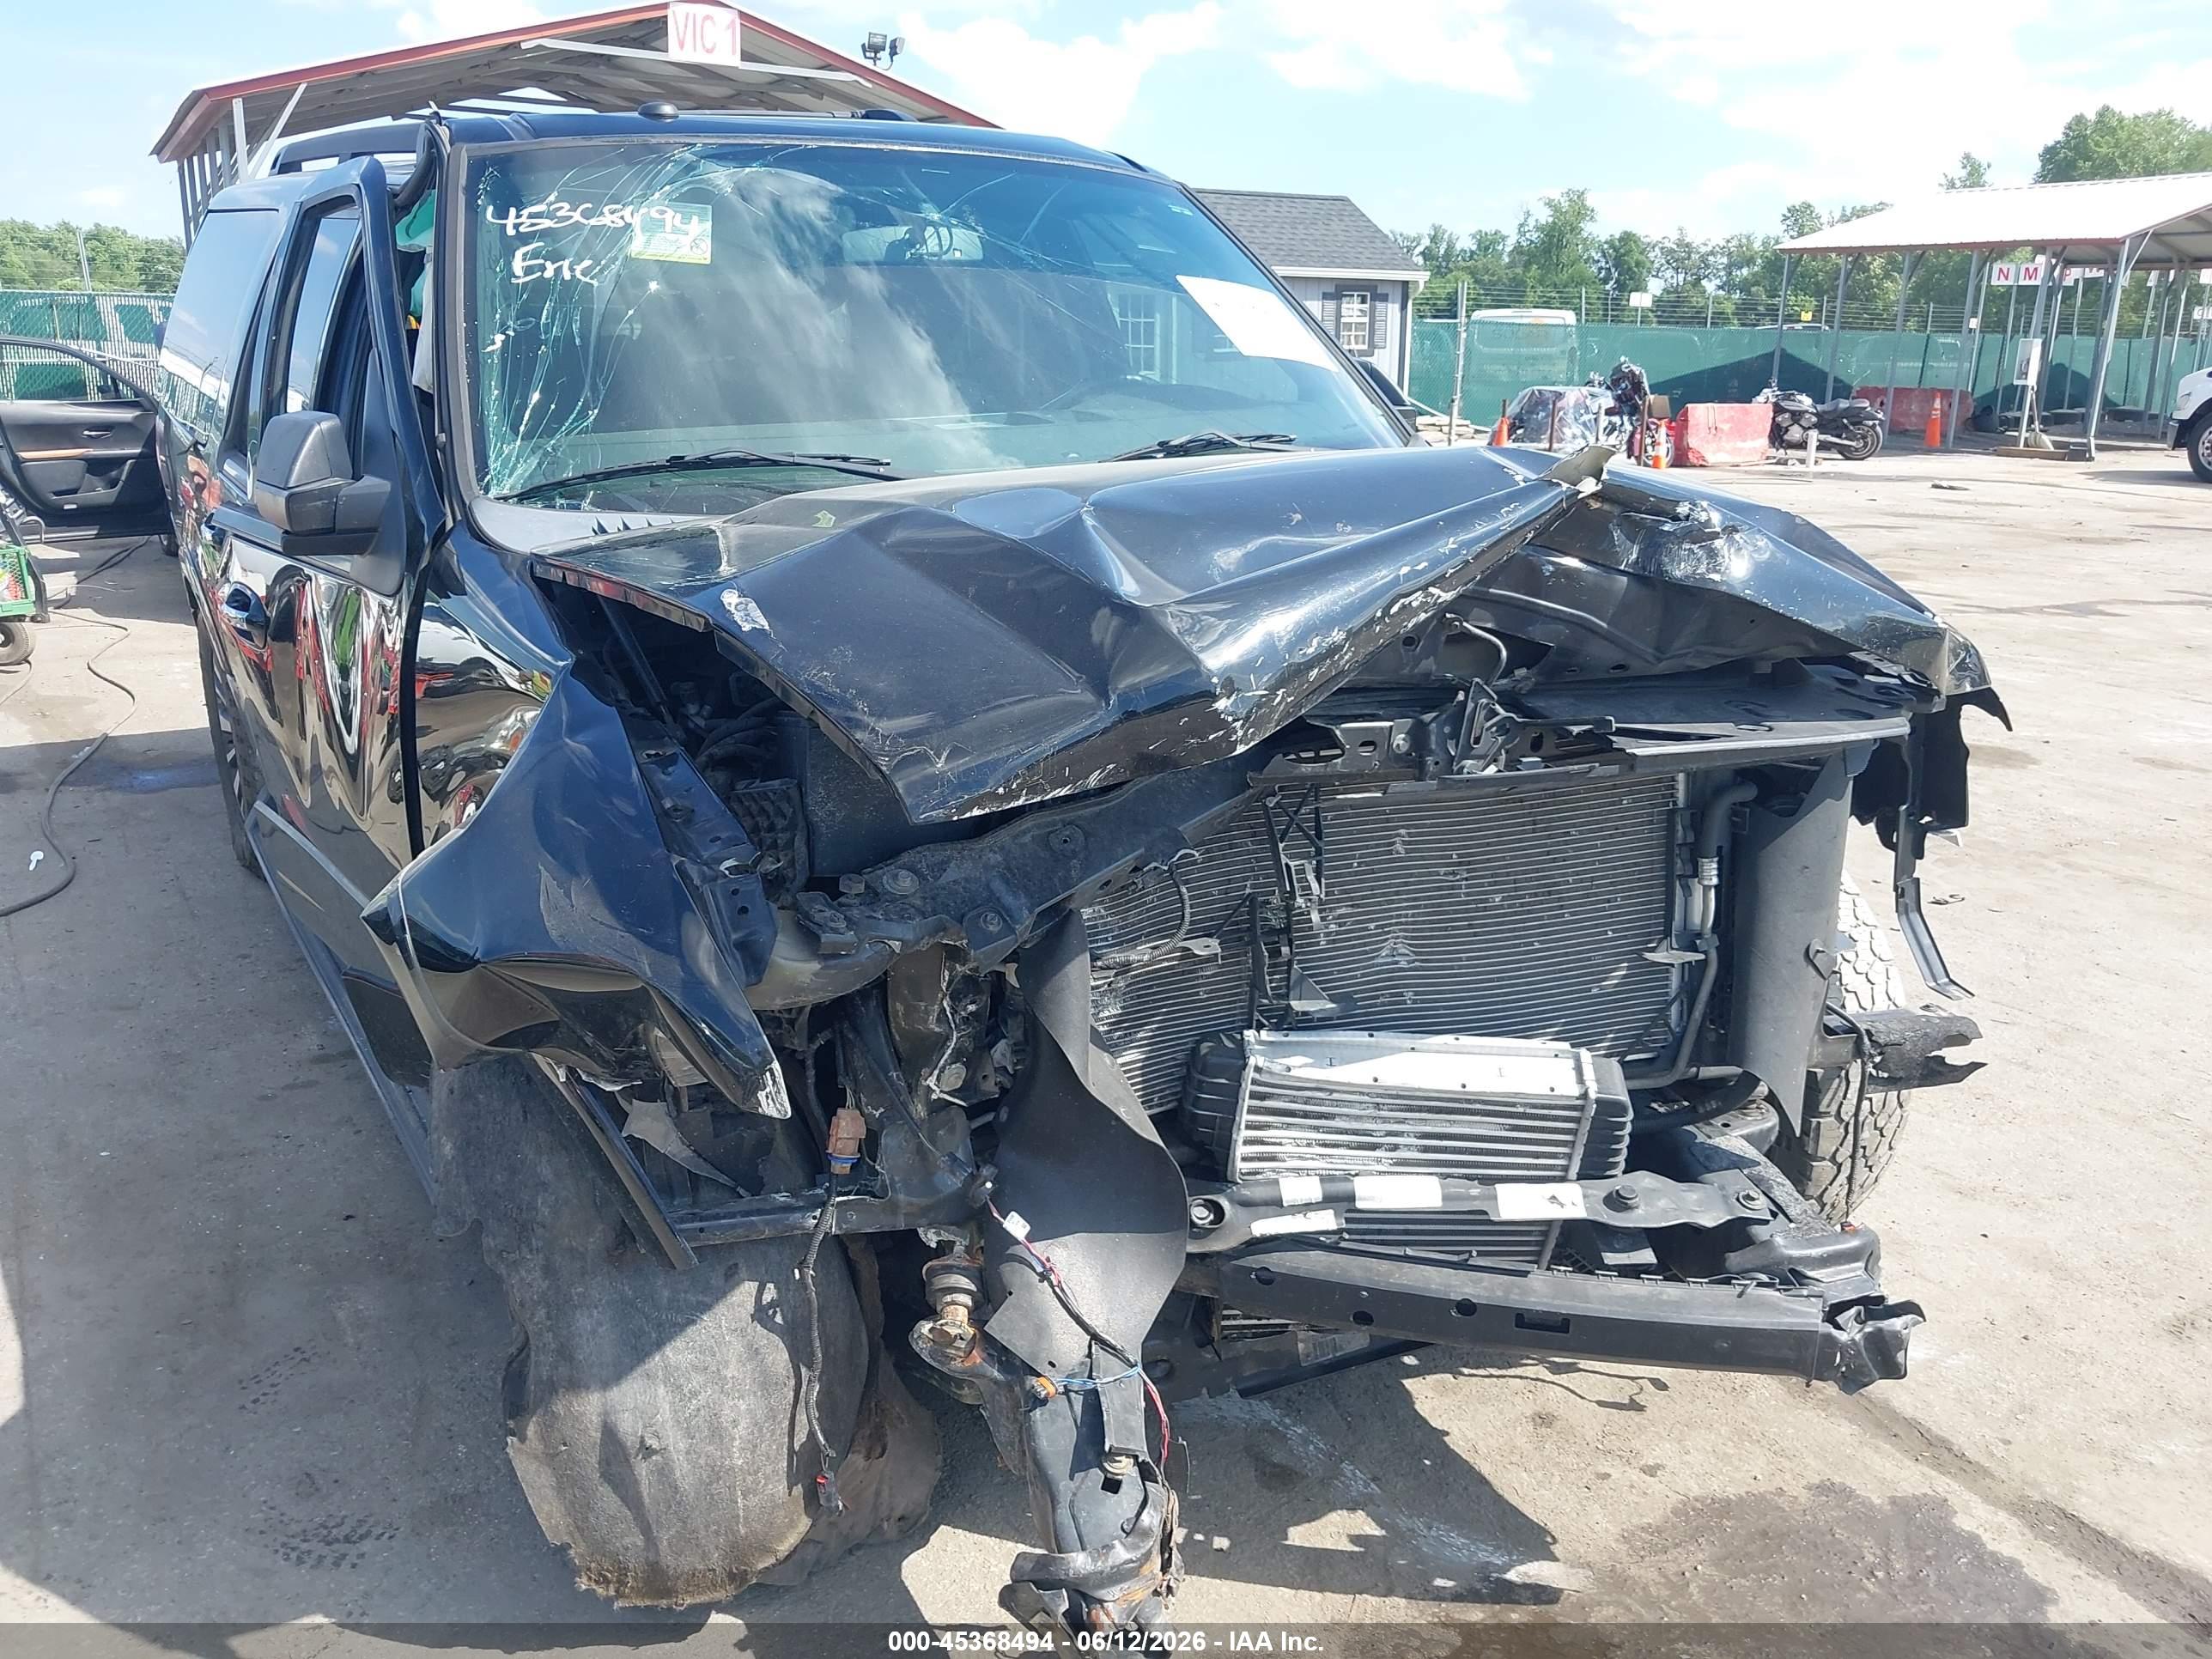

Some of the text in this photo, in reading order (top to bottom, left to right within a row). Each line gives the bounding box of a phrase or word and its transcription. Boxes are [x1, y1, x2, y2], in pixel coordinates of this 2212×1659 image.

[672, 10, 737, 55] VIC 1
[1997, 267, 2010, 281] N
[2023, 267, 2039, 281] M
